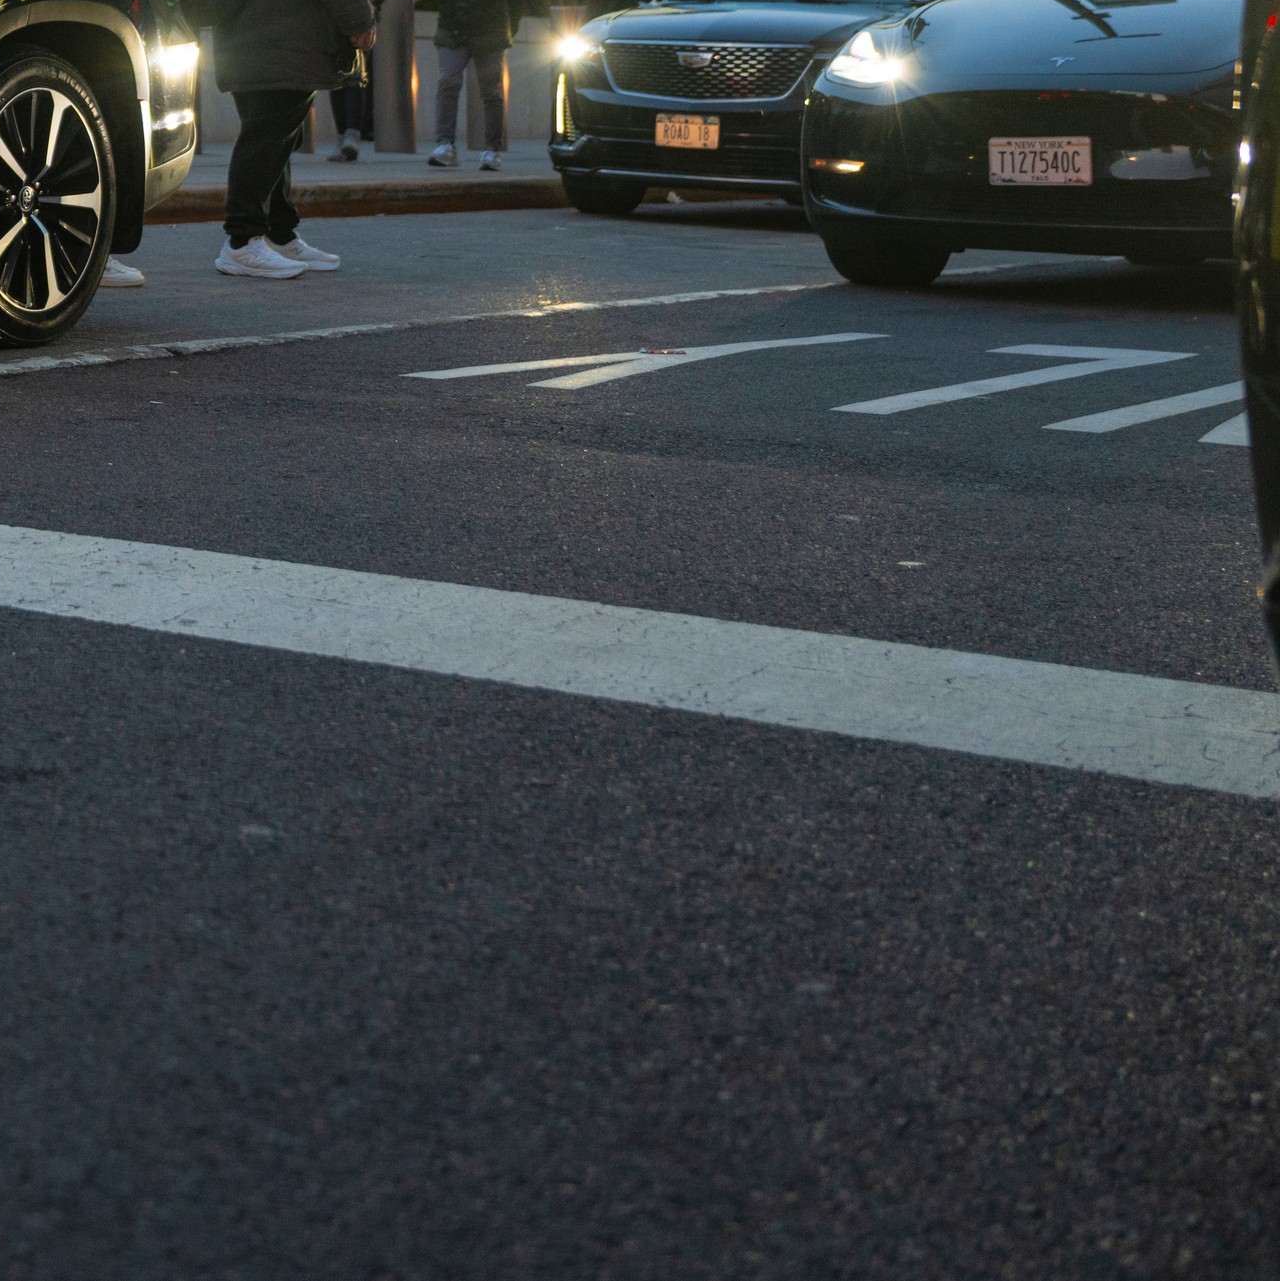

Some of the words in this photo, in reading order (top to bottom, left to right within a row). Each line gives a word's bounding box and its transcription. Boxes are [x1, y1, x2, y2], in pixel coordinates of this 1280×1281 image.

[663, 124, 690, 140] ROAD
[1014, 141, 1036, 149] NEW
[1038, 140, 1064, 149] YORK
[998, 151, 1080, 174] T127540C
